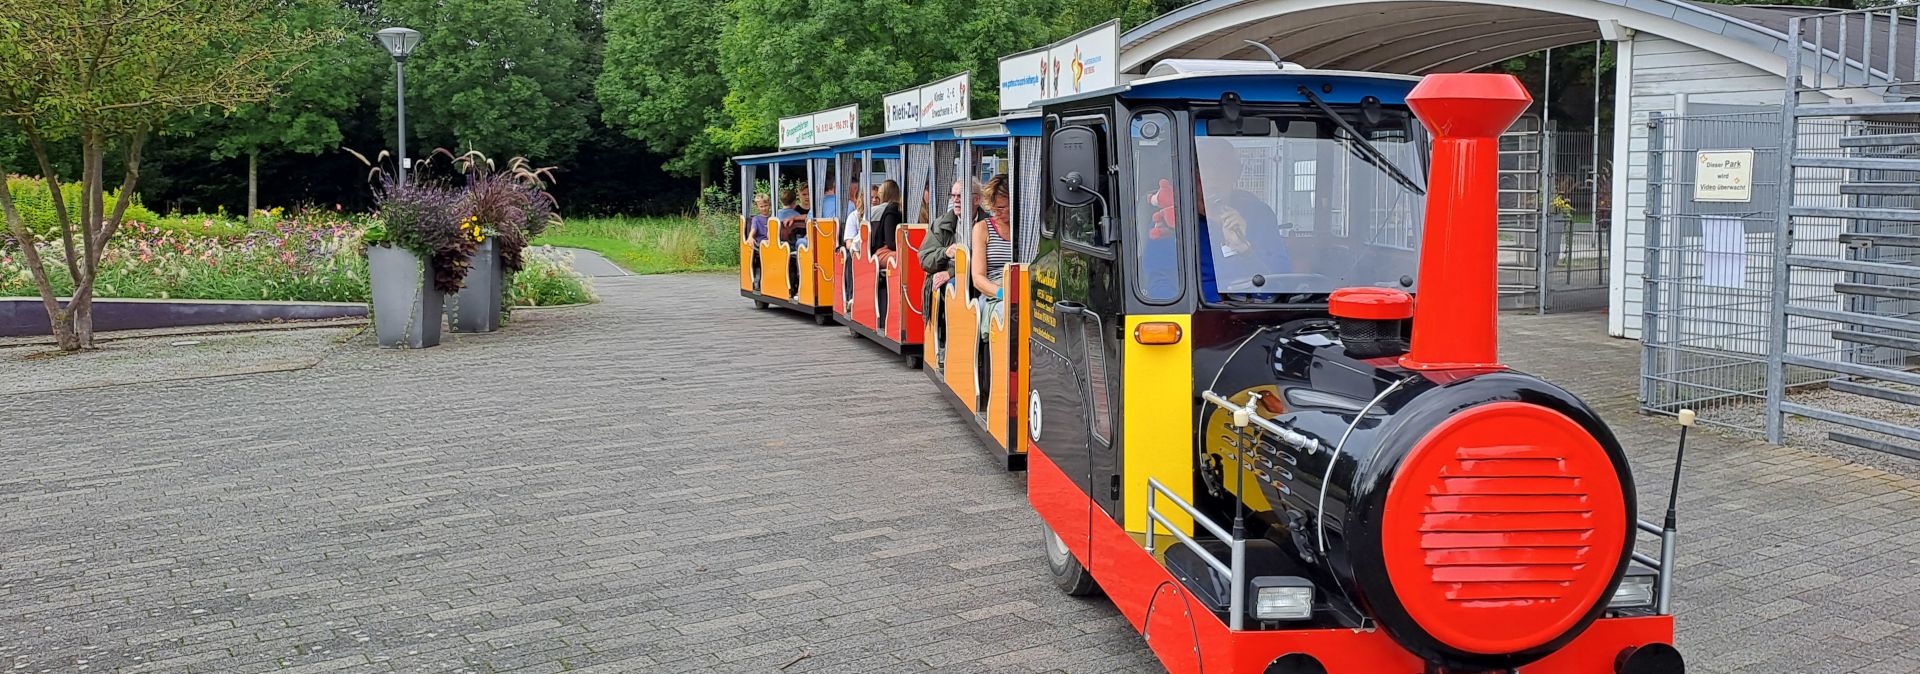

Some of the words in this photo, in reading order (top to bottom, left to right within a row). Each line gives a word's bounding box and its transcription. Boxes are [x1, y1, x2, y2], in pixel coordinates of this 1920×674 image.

[934, 91, 944, 102] Kinder
[892, 102, 918, 122] Rieti-Zug
[932, 106, 950, 118] Erwachsene
[1724, 160, 1741, 168] Park
[1033, 401, 1038, 431] 6
